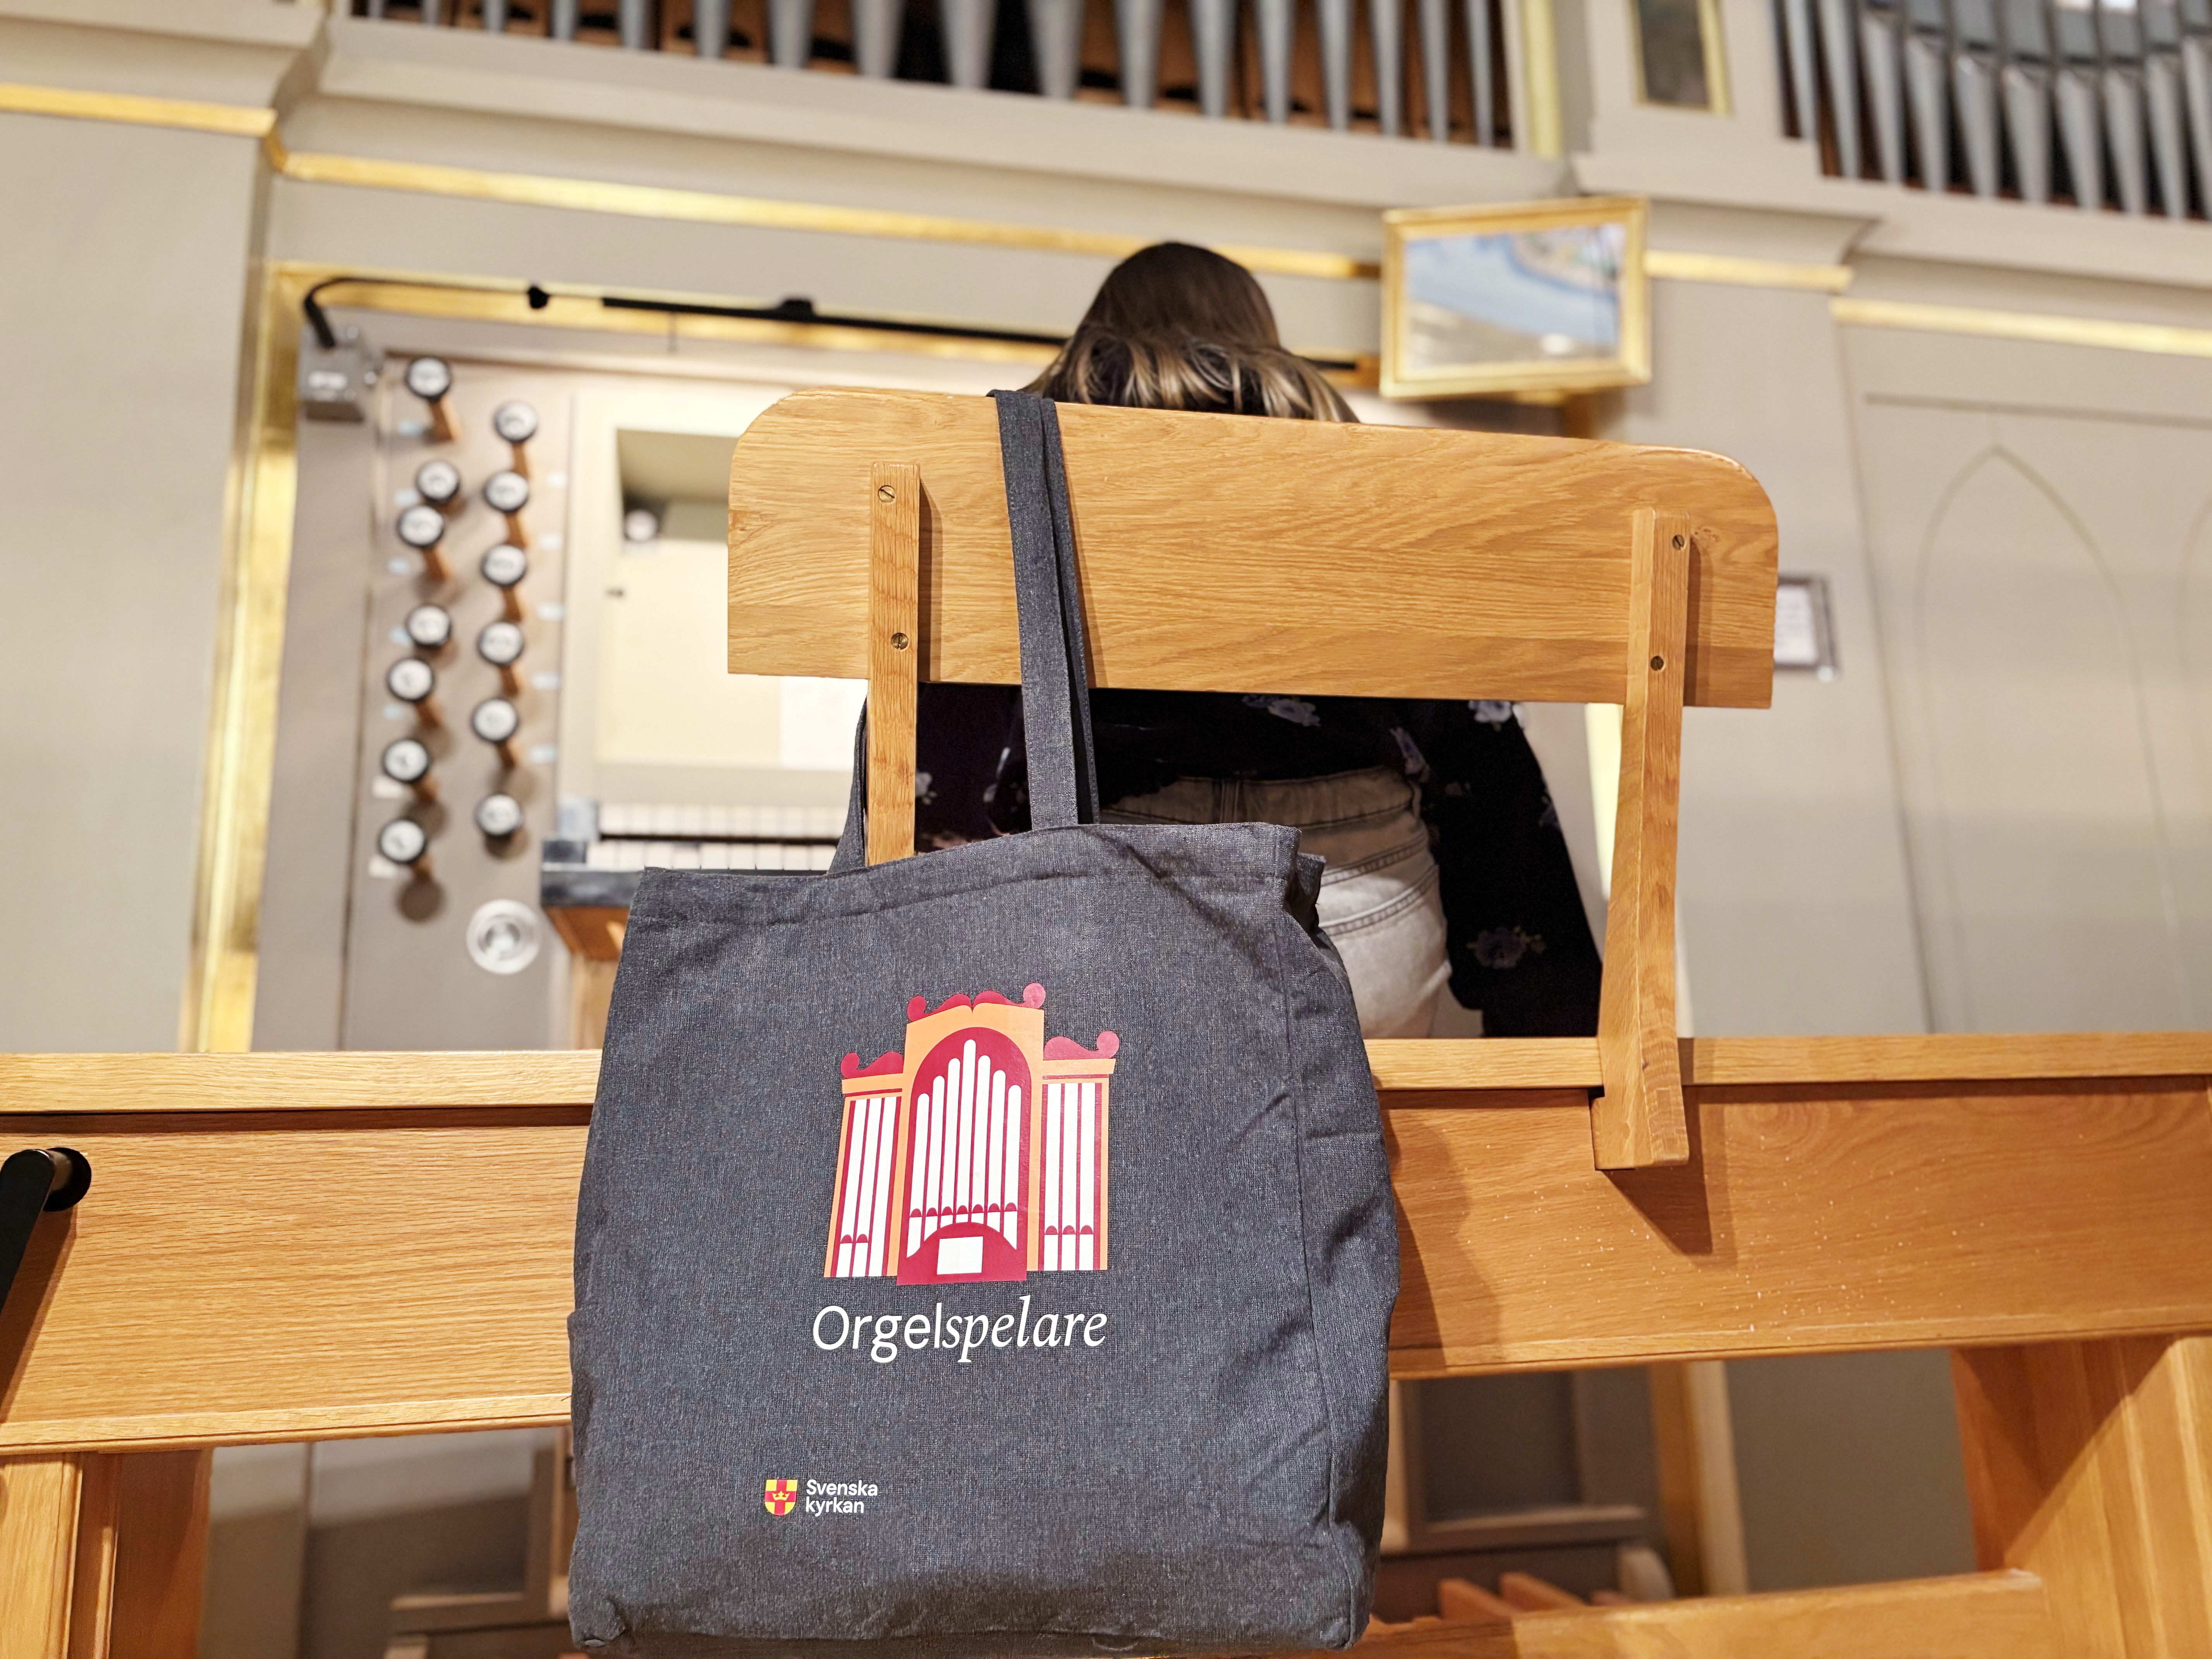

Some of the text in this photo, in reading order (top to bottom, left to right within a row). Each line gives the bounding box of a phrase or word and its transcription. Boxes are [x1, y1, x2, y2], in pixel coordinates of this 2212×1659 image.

[813, 1295, 1108, 1363] Orgelspelare
[806, 1479, 878, 1496] Svenska
[805, 1496, 864, 1517] kyrkan
